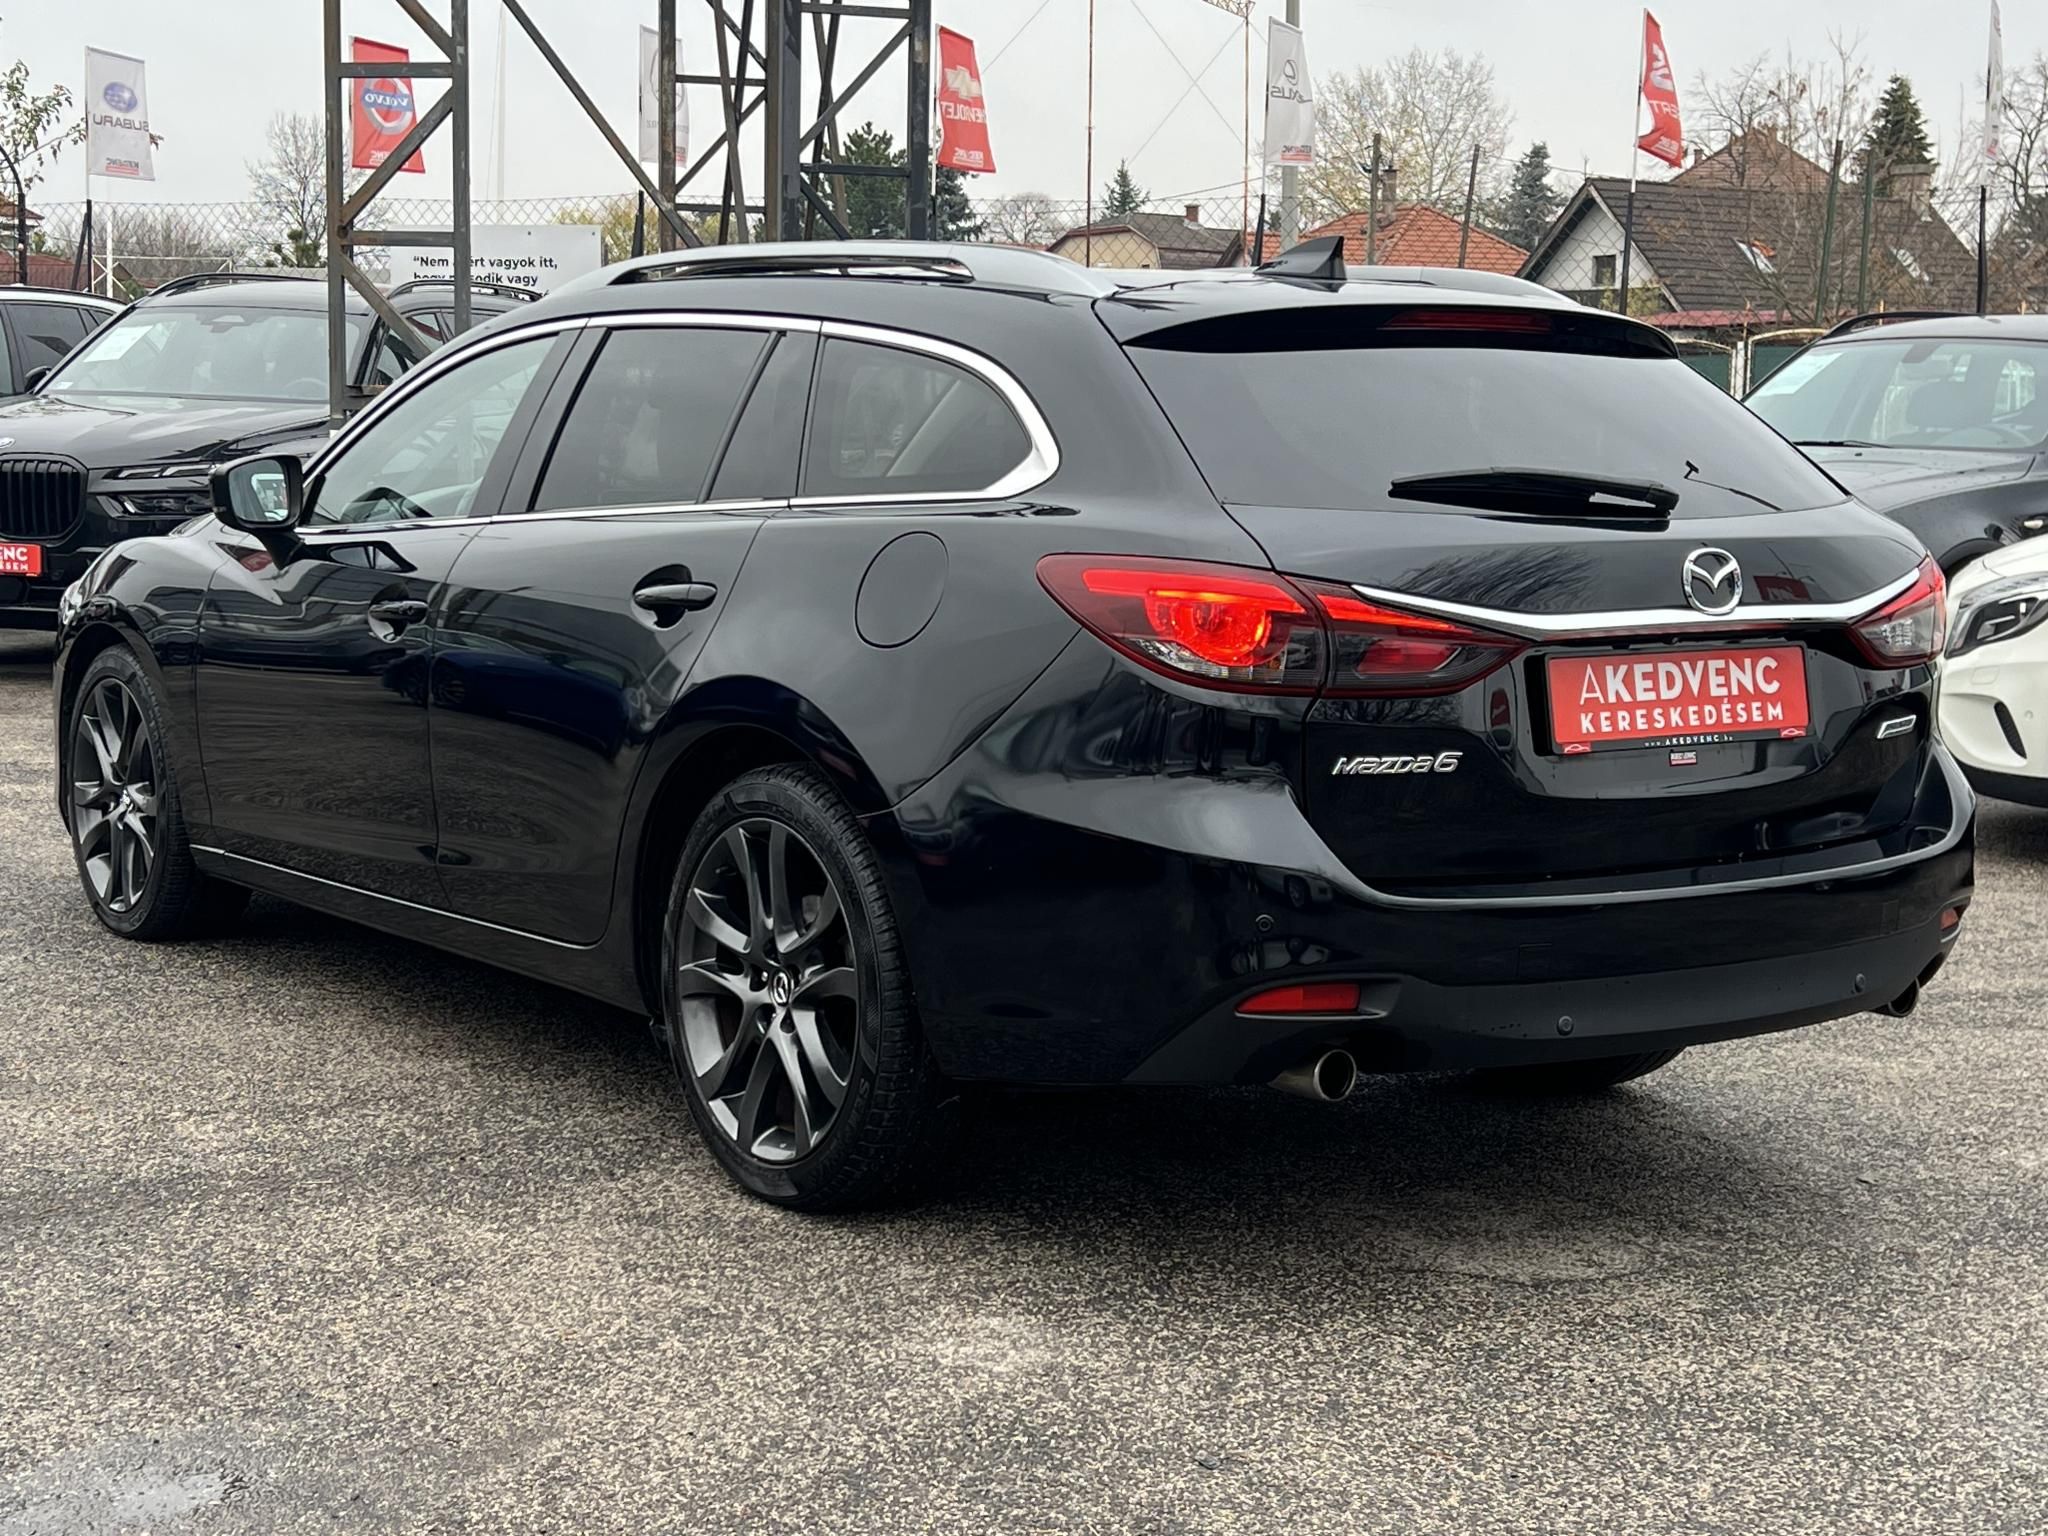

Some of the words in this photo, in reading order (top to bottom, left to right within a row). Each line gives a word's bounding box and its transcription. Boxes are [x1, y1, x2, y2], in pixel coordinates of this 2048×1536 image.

[489, 256, 535, 270] vagyok
[539, 256, 558, 270] itt,
[507, 275, 538, 287] vagy
[1579, 656, 1781, 705] AKEDVENC
[1580, 697, 1784, 734] KERESKEDÉSEM
